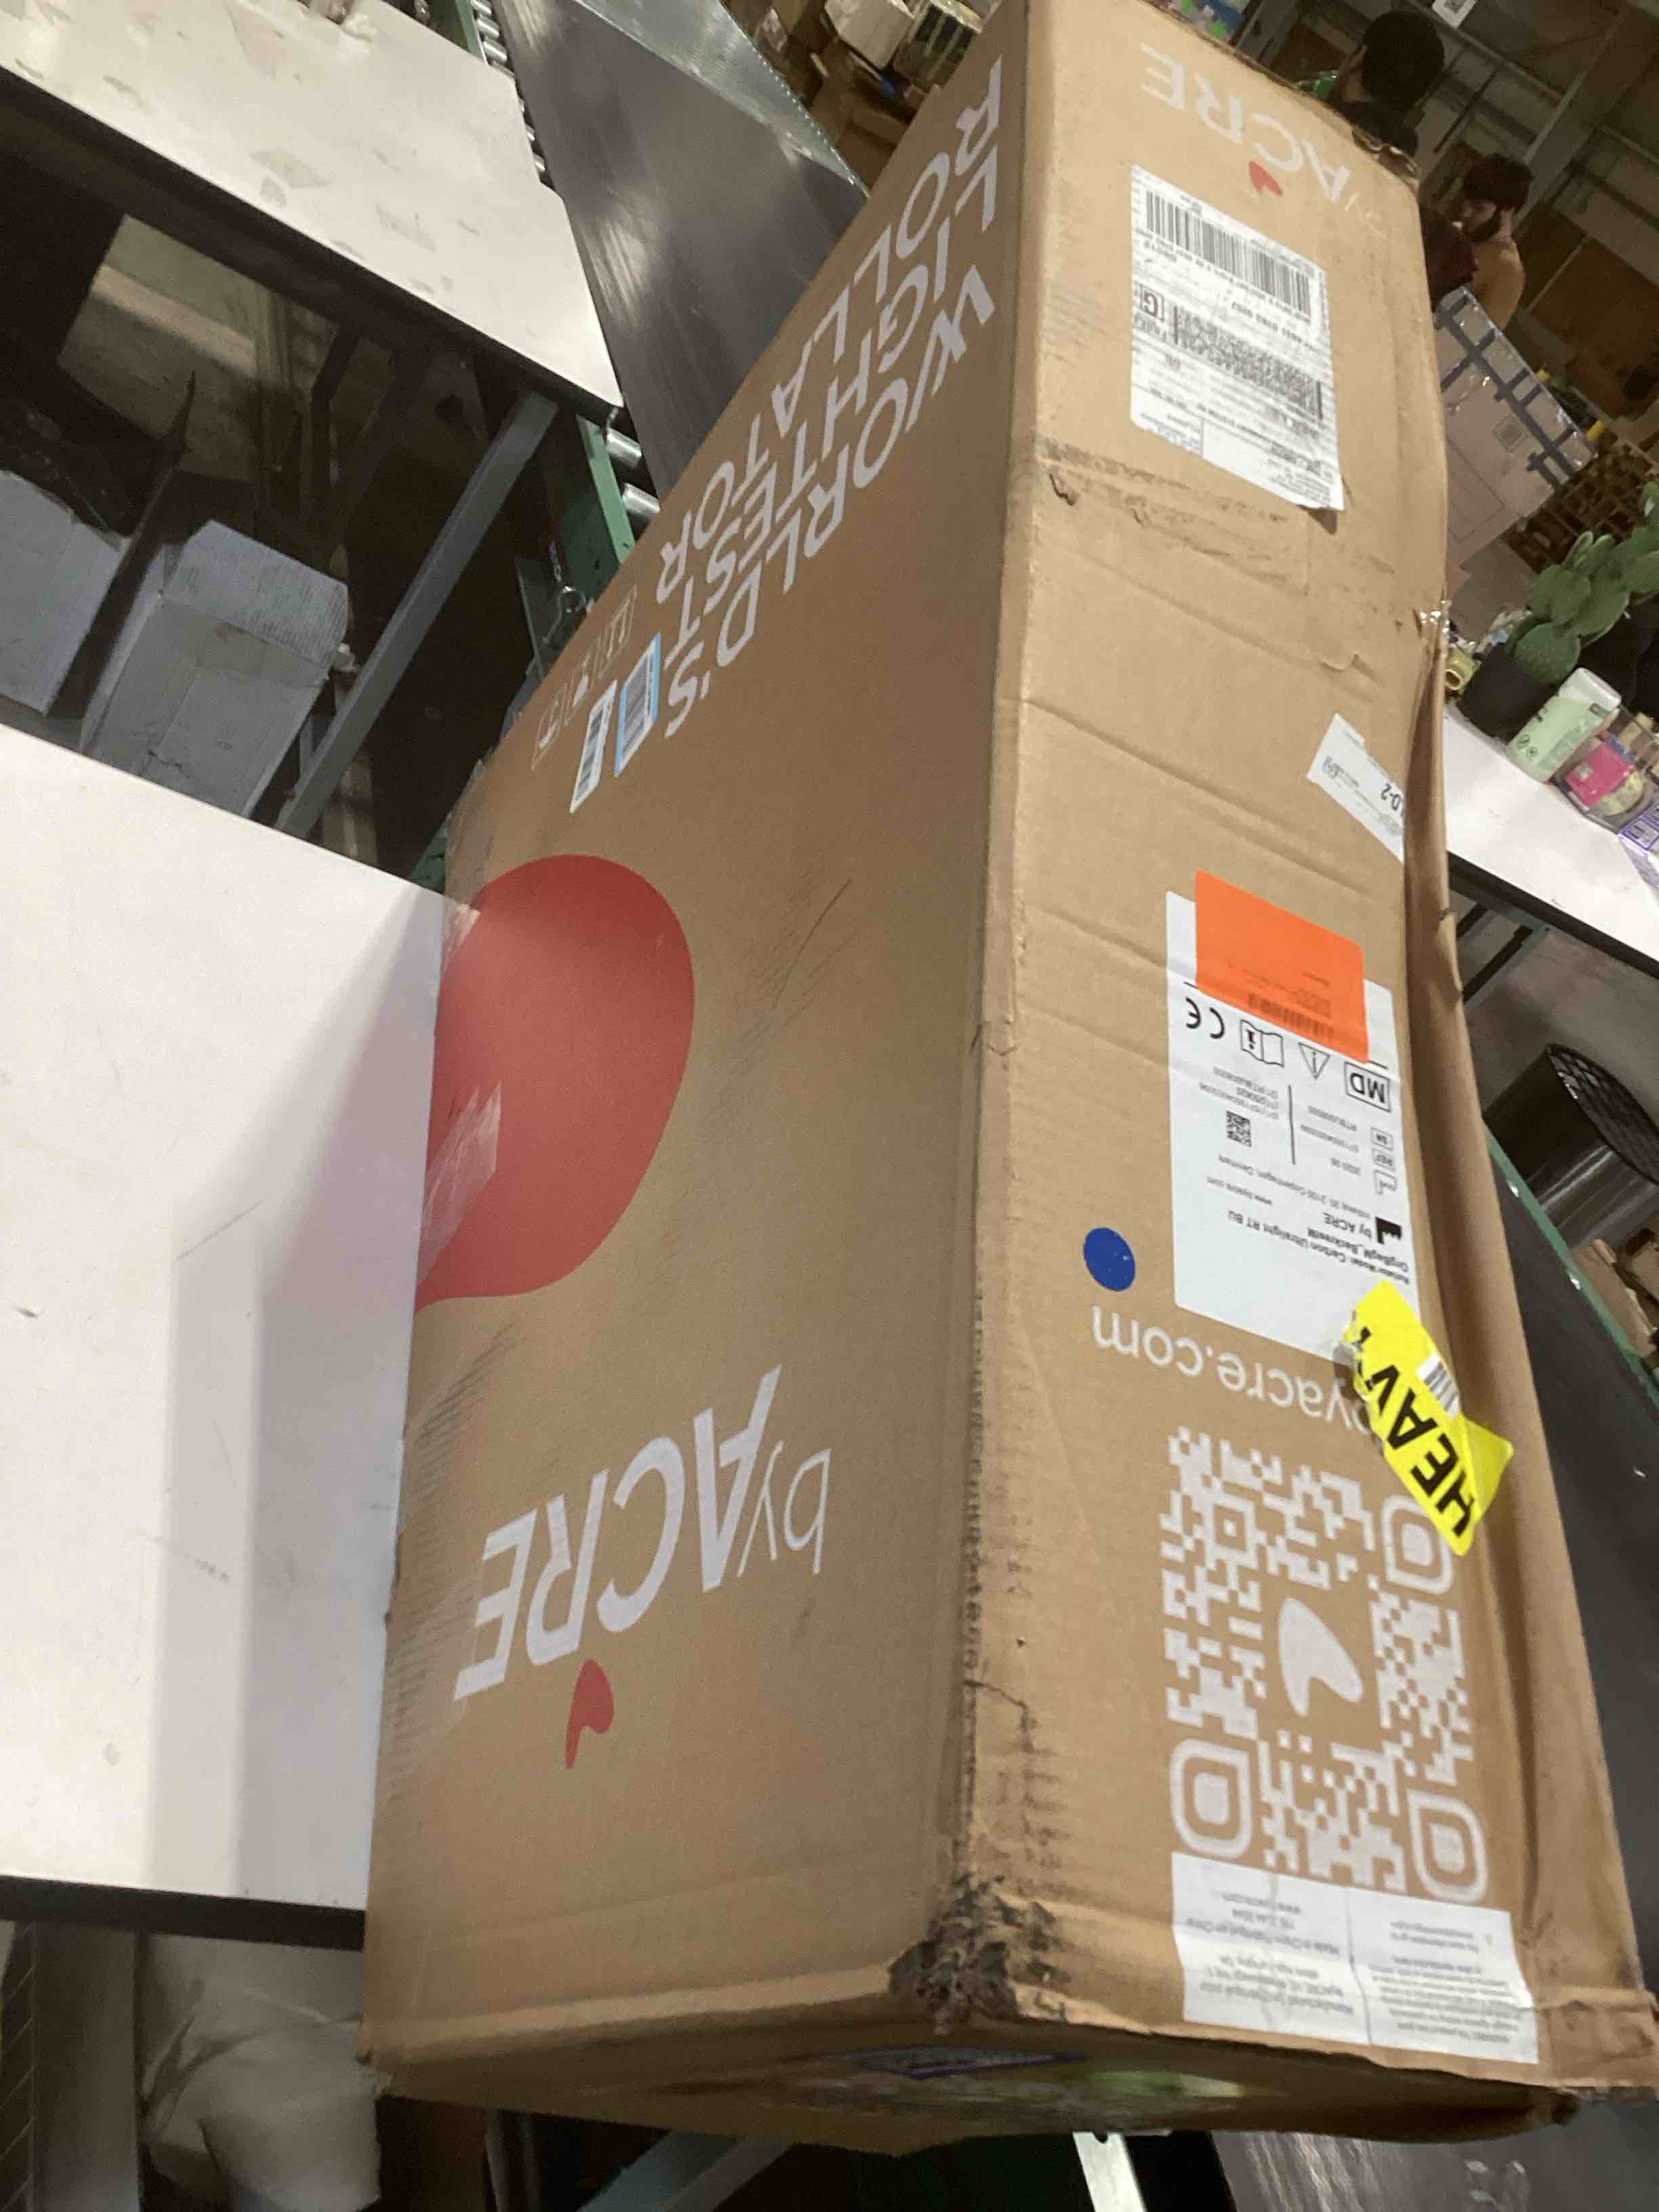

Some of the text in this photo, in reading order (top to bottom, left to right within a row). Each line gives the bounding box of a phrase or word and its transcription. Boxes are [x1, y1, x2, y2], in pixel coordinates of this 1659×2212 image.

[1141, 43, 1350, 203] ACRE
[657, 56, 1001, 605] ROLLATOR
[665, 142, 997, 672] LIGHTEST
[665, 264, 996, 739] WORLD'S
[1349, 1069, 1386, 1105] MD
[1227, 1209, 1243, 1225] BU
[1311, 1241, 1346, 1264] Carbon
[1322, 1211, 1372, 1241] by ACRE
